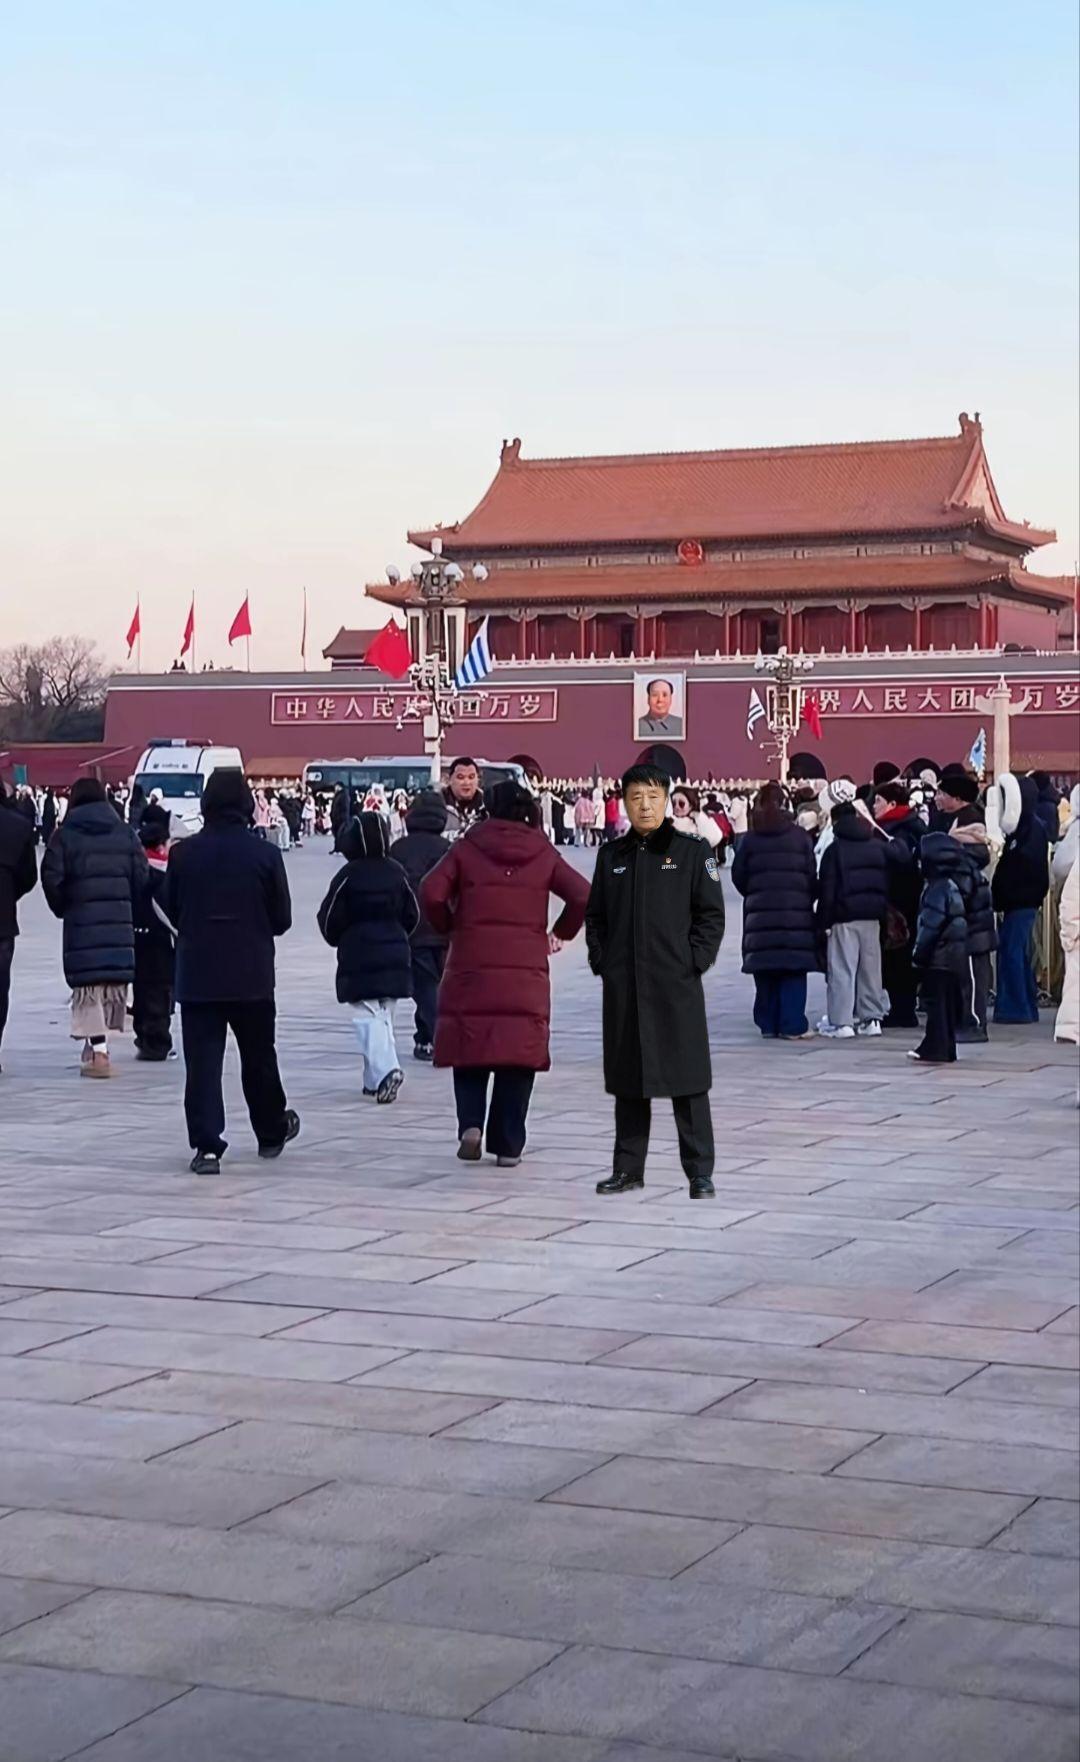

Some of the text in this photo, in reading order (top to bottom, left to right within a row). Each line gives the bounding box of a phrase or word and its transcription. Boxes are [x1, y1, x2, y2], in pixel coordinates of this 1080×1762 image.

[286, 695, 541, 718] 中华人民共国万岁
[800, 685, 1080, 711] 界人民大团万岁
